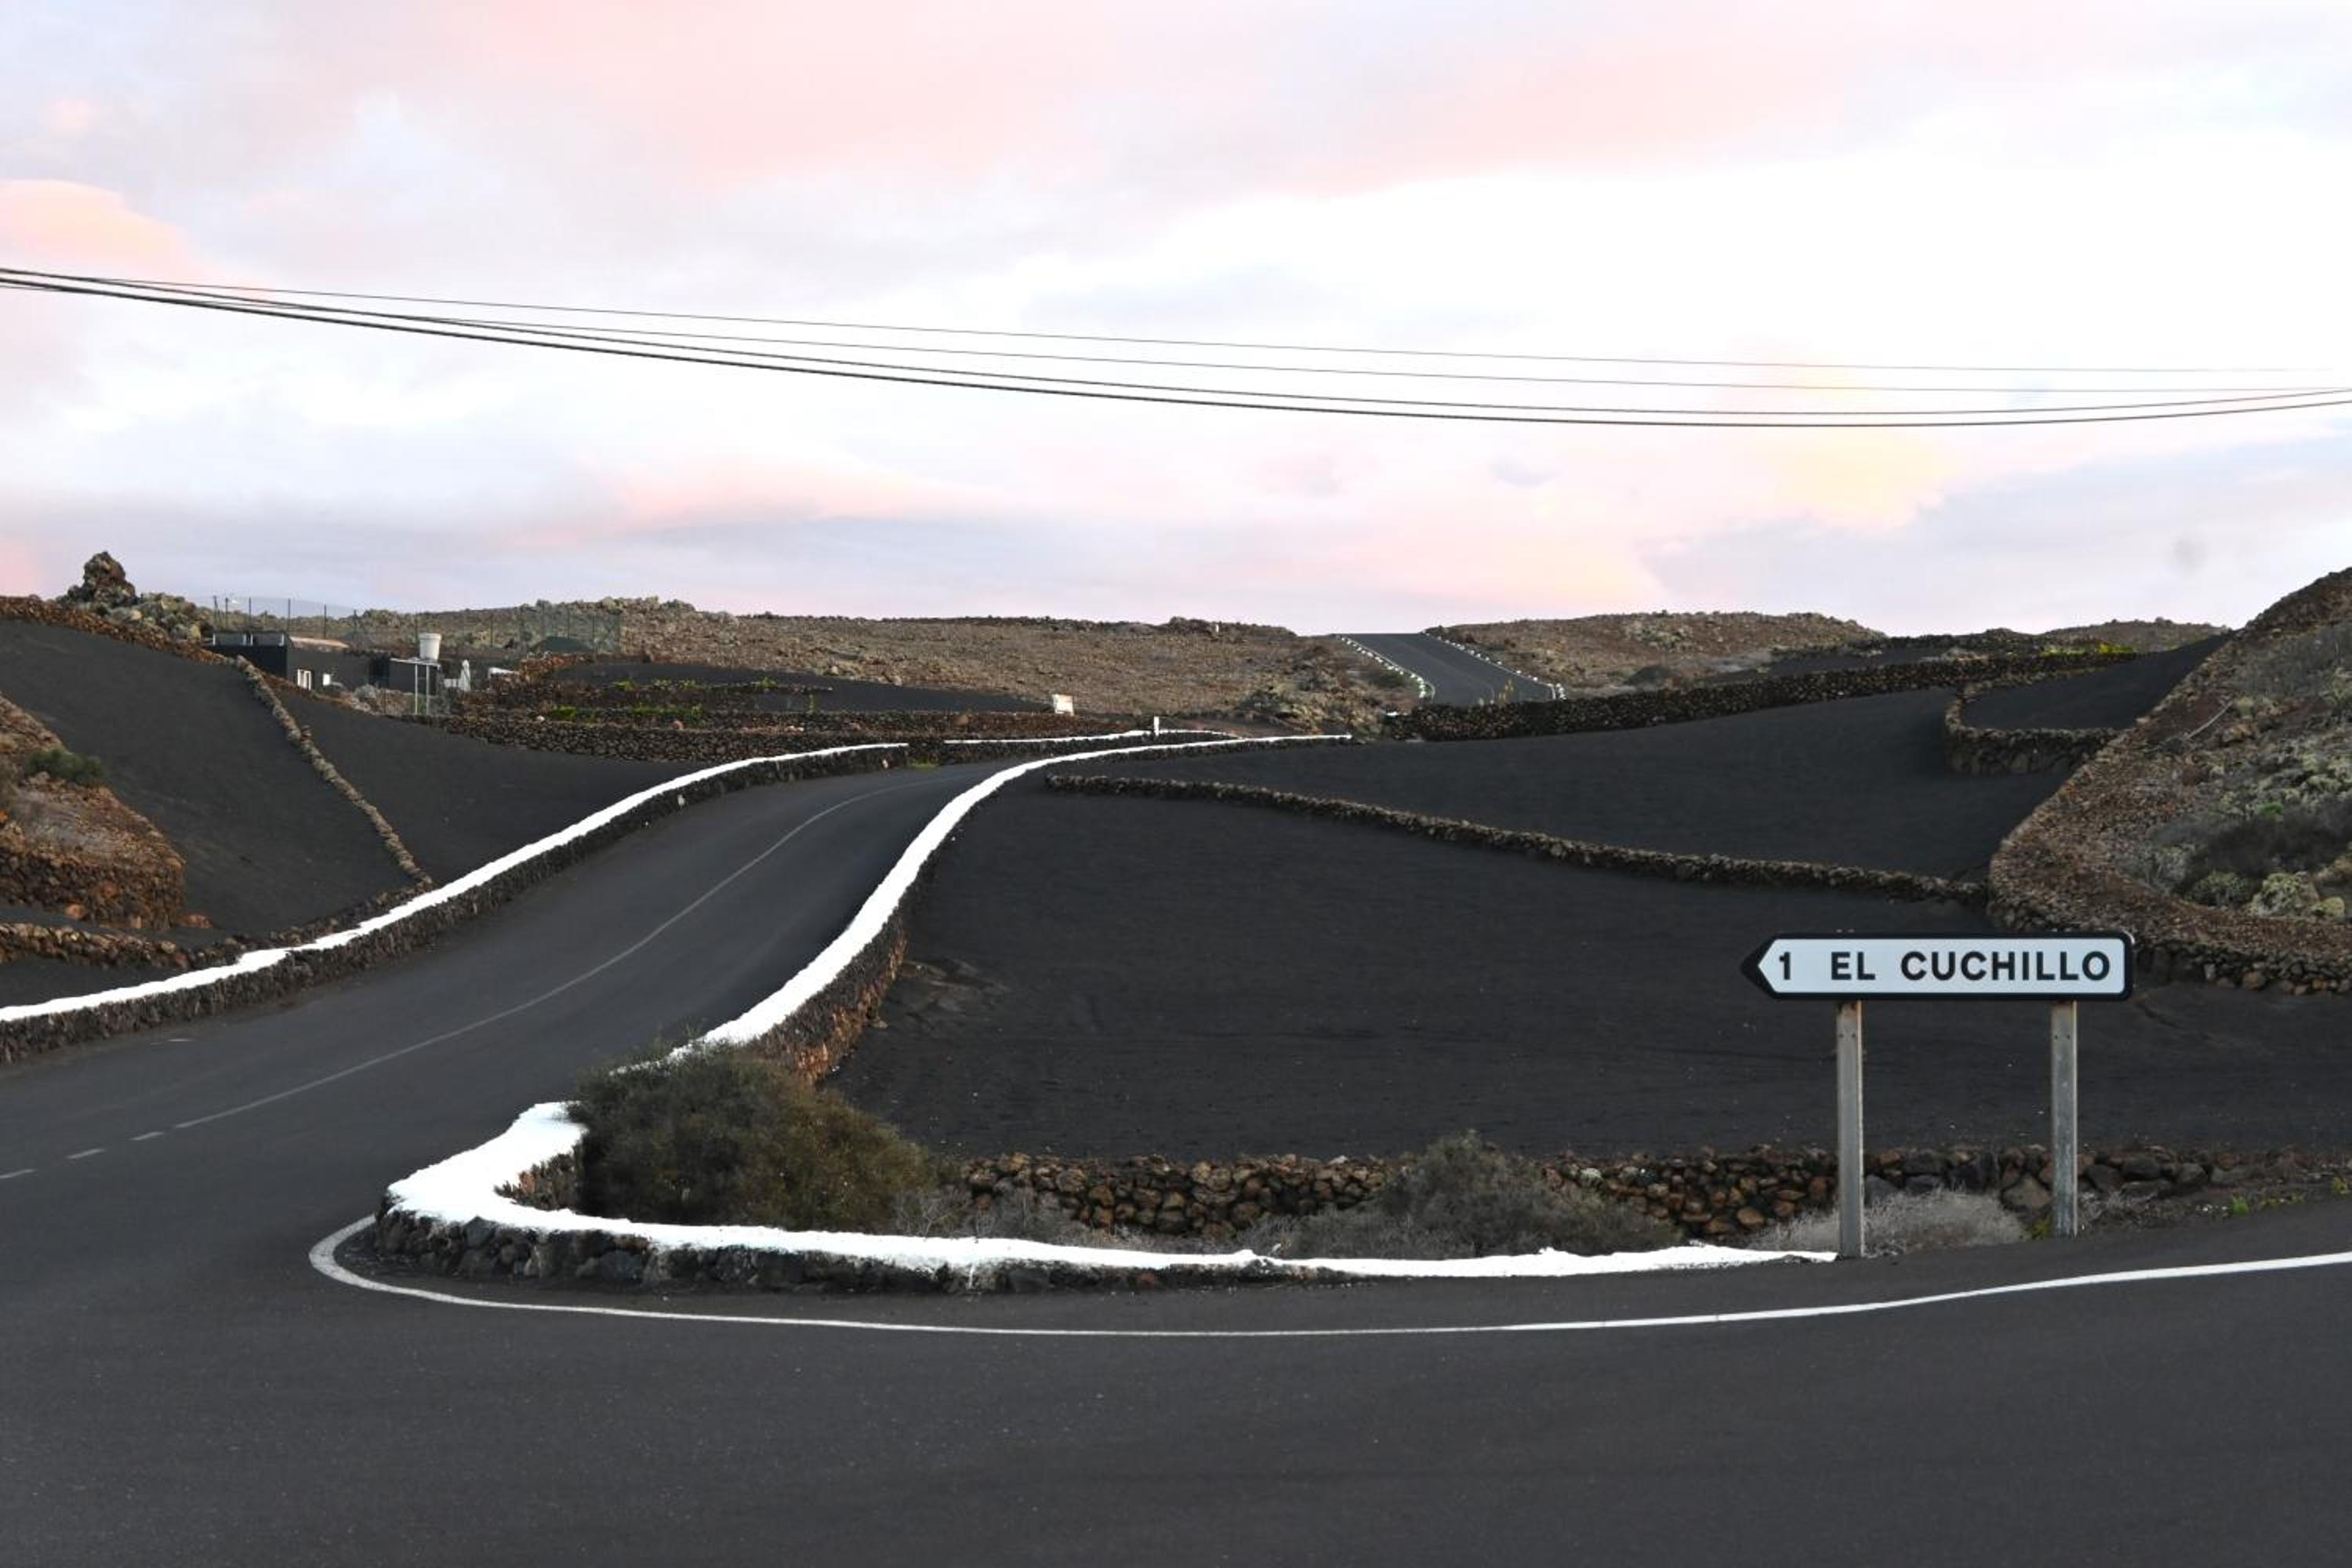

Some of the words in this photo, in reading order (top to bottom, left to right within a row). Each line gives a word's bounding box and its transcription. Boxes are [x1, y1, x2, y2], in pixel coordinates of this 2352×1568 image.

[1779, 951, 1791, 981] 1
[1831, 951, 1876, 981] EL
[1900, 951, 2111, 982] CUCHILLO
